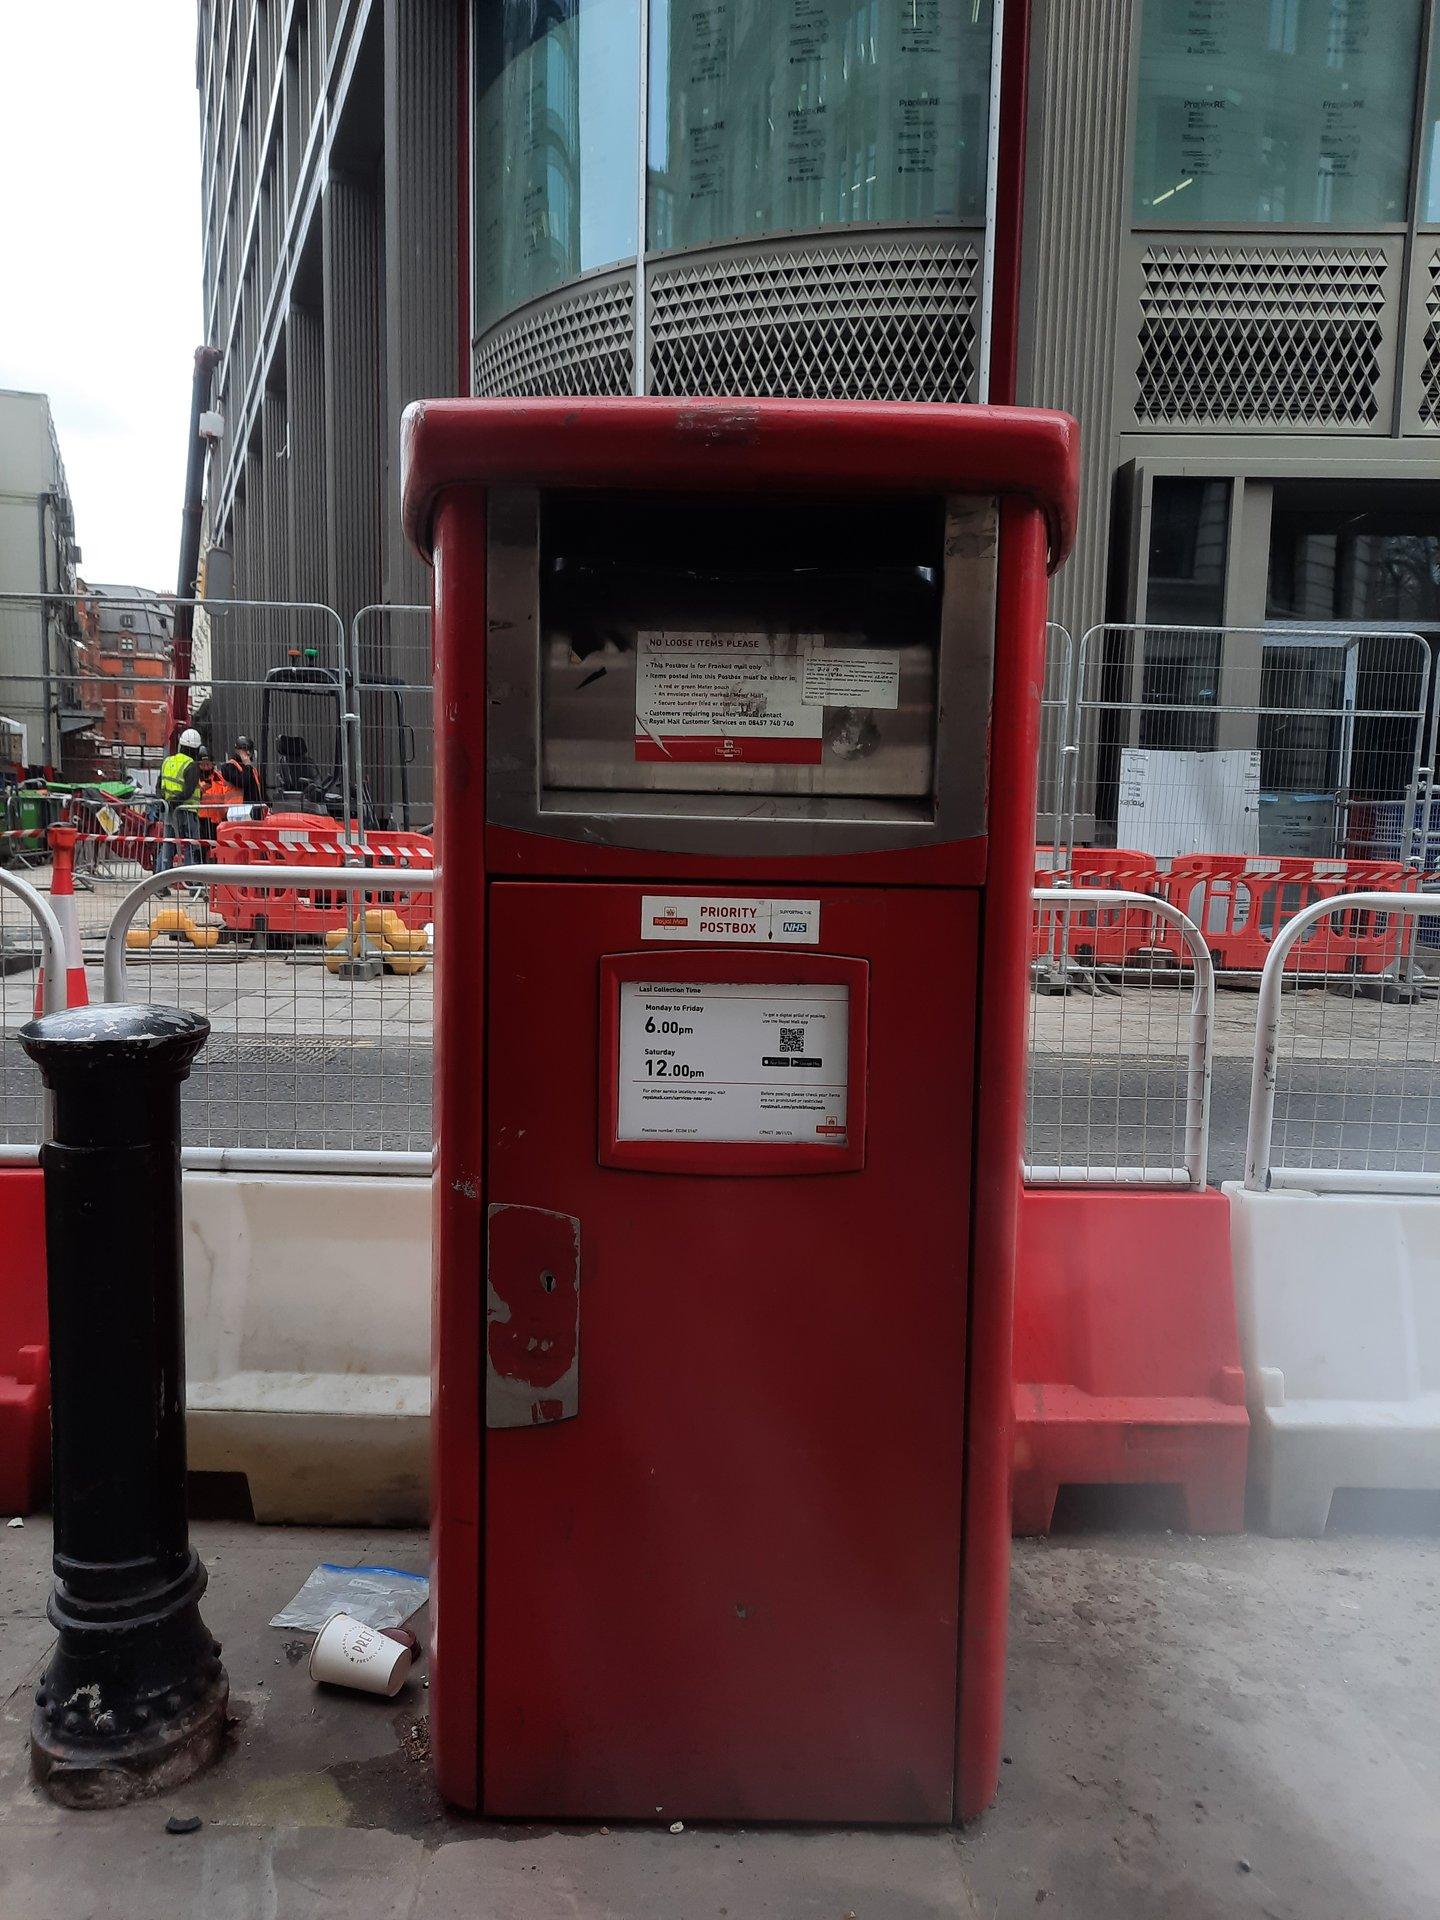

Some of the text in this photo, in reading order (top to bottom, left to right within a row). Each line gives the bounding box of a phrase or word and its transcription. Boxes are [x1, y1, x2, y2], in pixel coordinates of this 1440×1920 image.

[650, 639, 760, 648] NO LOOSE ITEMS PLEASE
[669, 673, 689, 681] posted
[650, 710, 681, 718] Customers
[683, 711, 710, 719] requiring
[649, 718, 666, 726] Royal
[700, 907, 757, 918] PRIORITY
[655, 918, 671, 926] Royal
[700, 922, 756, 934] POSTBOX
[784, 923, 806, 933] NHS
[645, 1004, 673, 1012] Monday
[682, 1005, 704, 1013] Friday
[645, 1016, 694, 1036] 6.00pm
[644, 1048, 676, 1057] Saturday
[645, 1059, 704, 1079] 12.00pm
[352, 1630, 375, 1653] PRET
